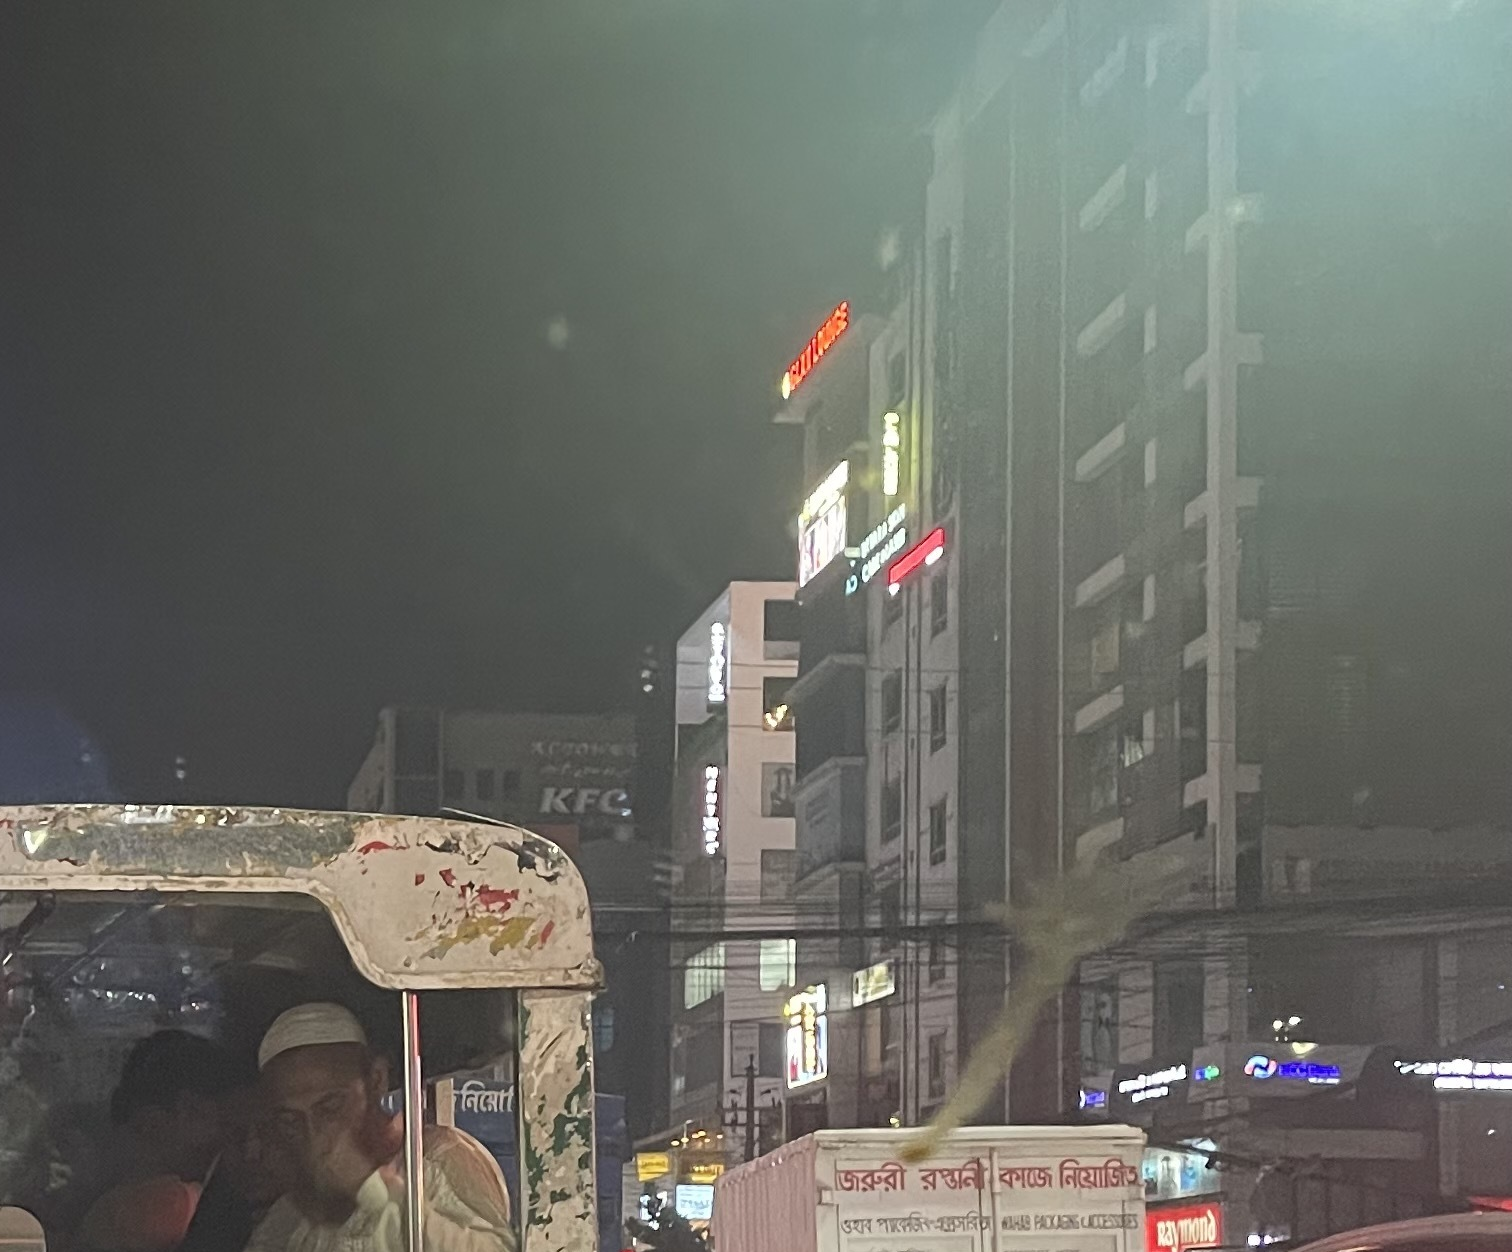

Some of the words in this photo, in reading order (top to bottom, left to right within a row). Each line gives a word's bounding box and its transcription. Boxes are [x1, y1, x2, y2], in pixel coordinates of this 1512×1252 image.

[539, 787, 632, 816] KFC
[838, 1161, 907, 1192] জরুরী
[999, 1167, 1053, 1189] কাজে
[1059, 1158, 1143, 1189] নিয়োজিত
